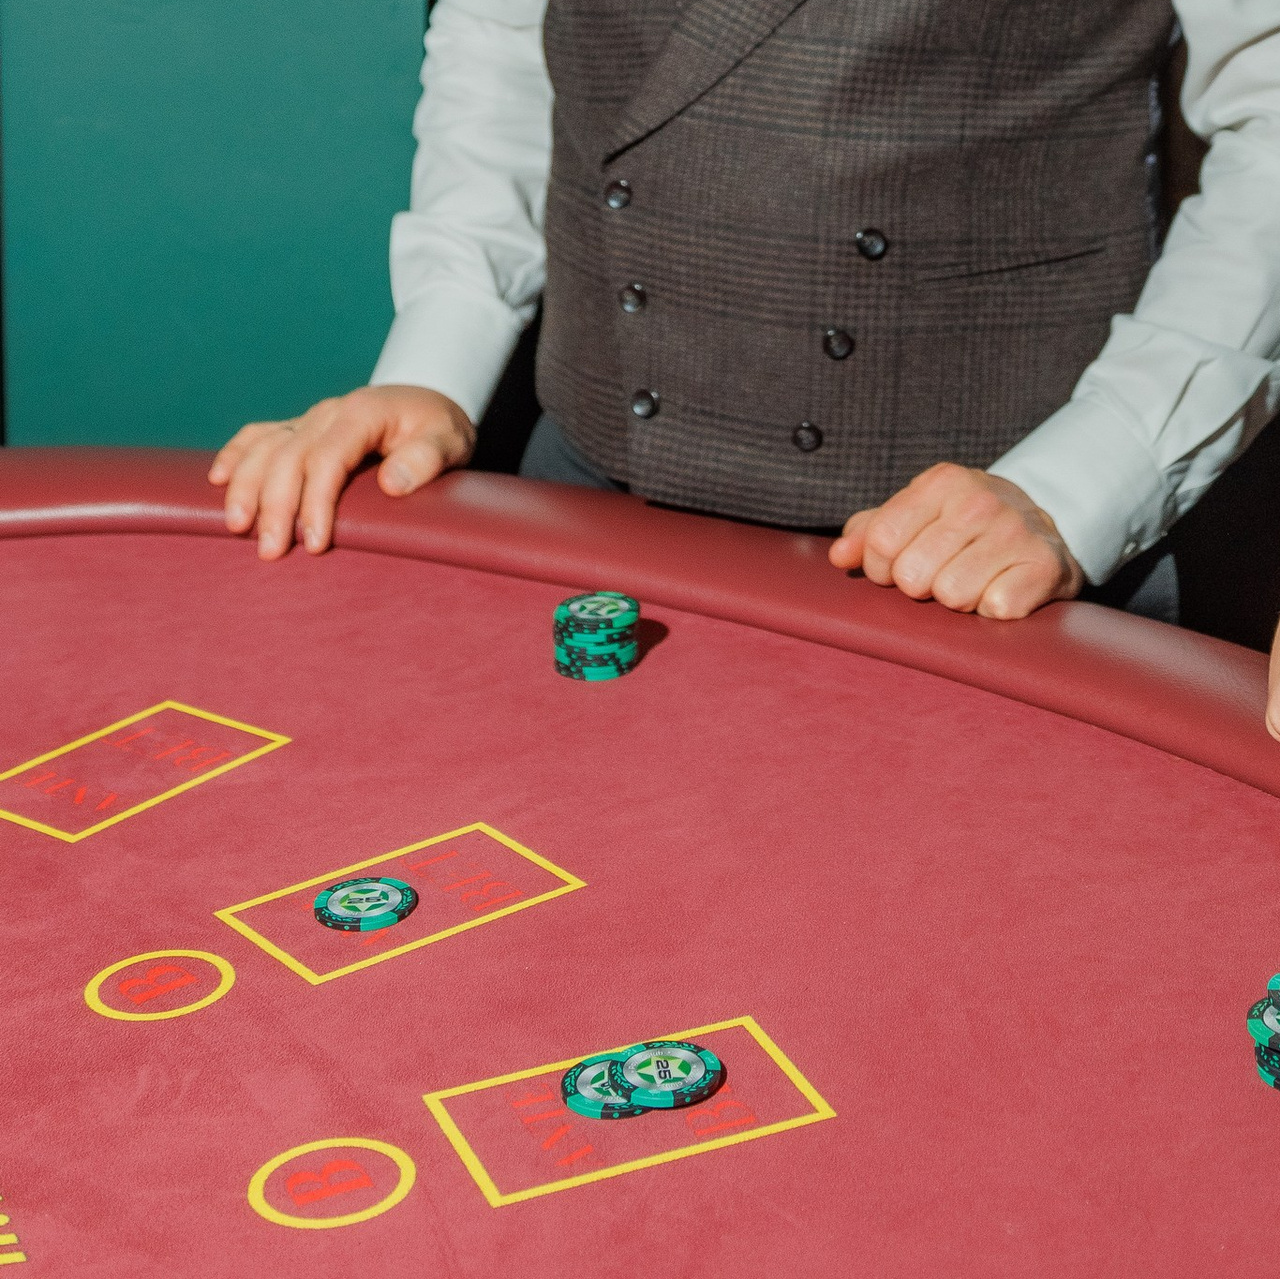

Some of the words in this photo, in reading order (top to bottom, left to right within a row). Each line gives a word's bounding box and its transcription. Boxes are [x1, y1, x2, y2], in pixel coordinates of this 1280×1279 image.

[400, 850, 524, 912] BET
[118, 964, 200, 1006] B
[656, 1060, 672, 1080] 25
[284, 1159, 374, 1207] B
